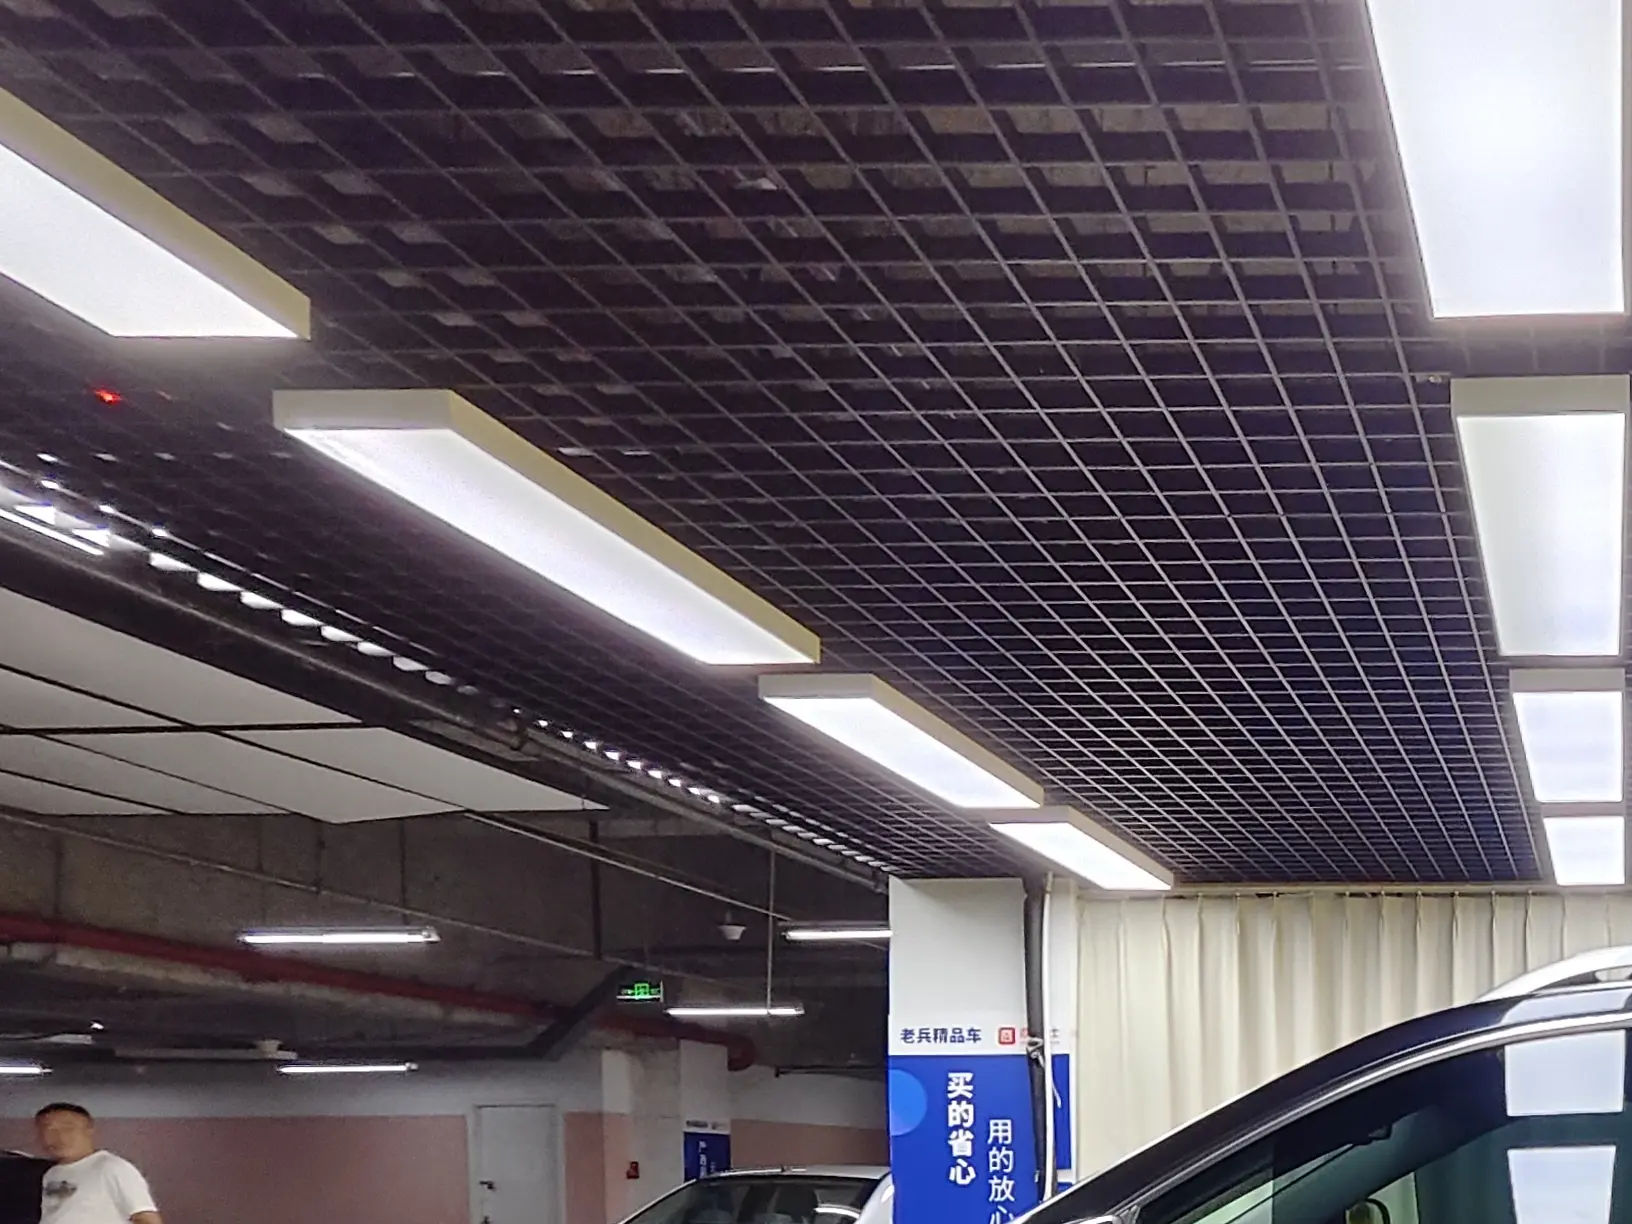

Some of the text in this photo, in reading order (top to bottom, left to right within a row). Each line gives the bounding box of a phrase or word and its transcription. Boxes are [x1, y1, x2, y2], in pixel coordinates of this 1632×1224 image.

[899, 1027, 982, 1045] 老兵精品车
[947, 1071, 976, 1185] 买的省心
